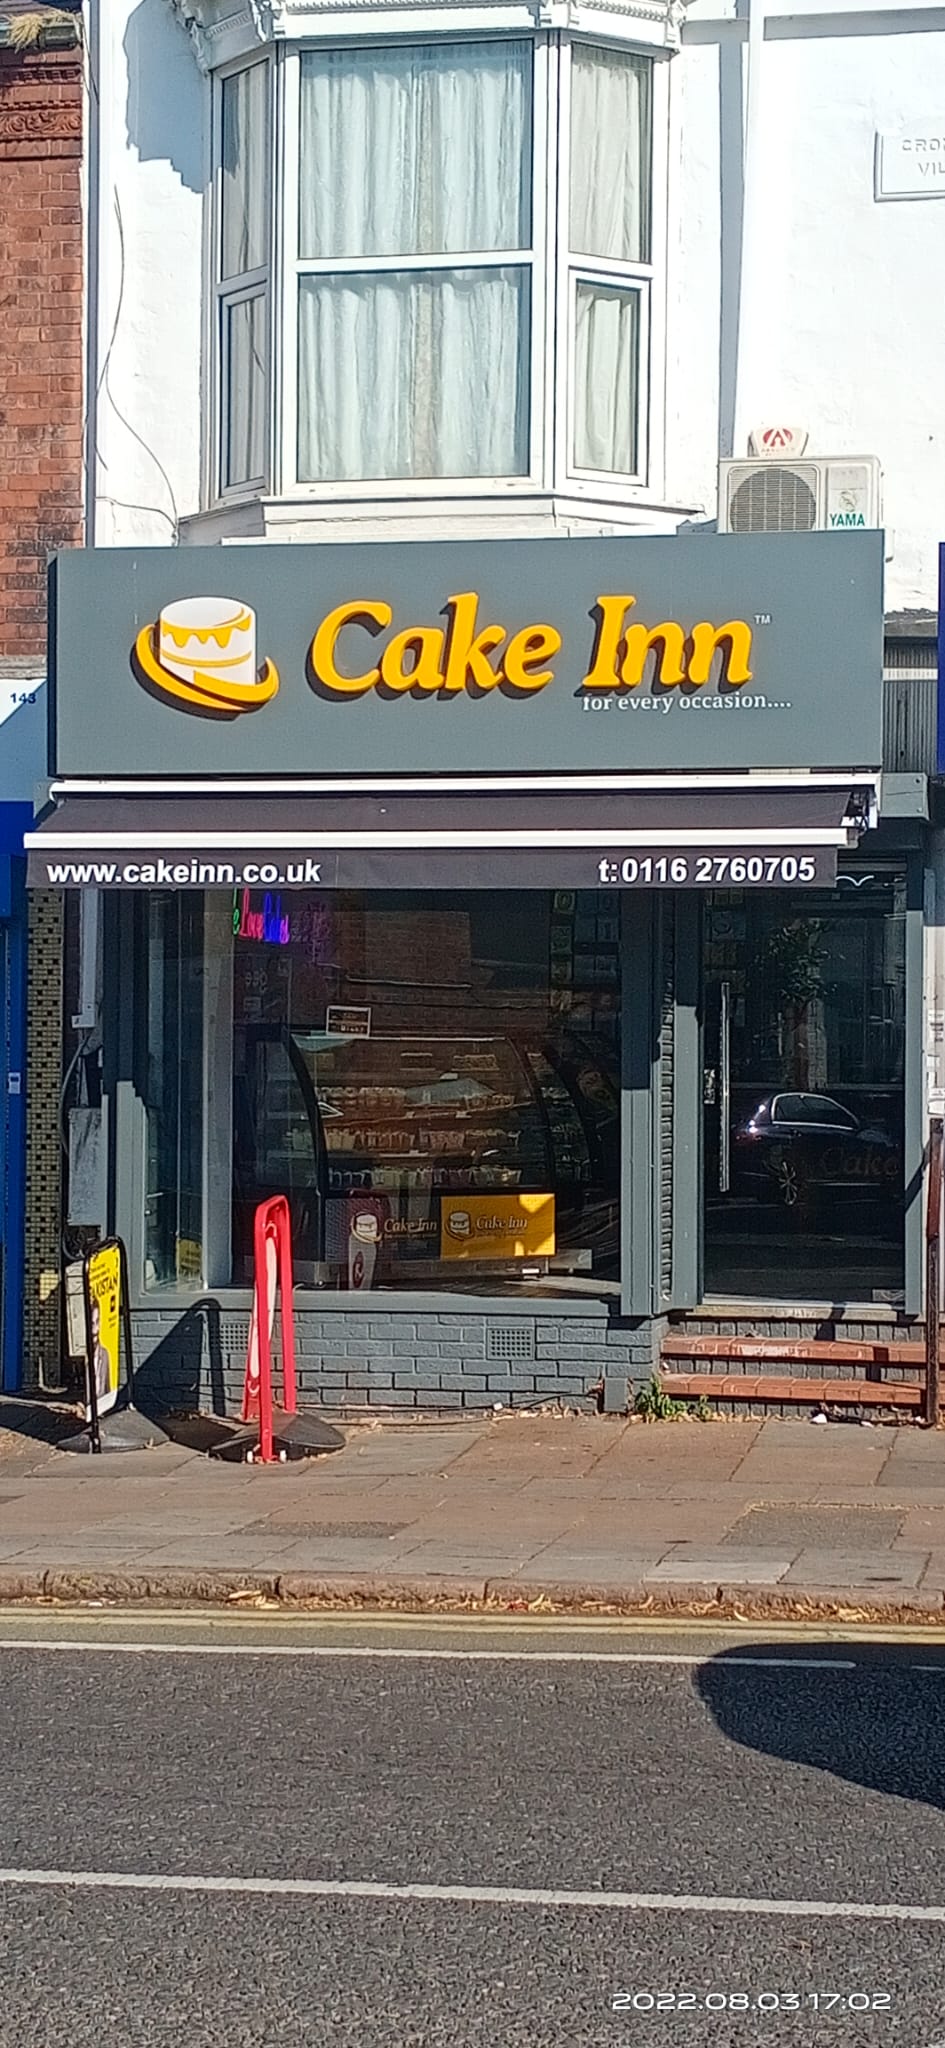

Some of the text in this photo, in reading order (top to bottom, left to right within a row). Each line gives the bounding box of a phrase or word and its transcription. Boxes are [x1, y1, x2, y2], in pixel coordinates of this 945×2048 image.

[829, 513, 865, 527] YAMA
[754, 614, 771, 625] TM
[310, 591, 753, 692] Cake Inn
[10, 692, 37, 704] 143
[583, 692, 792, 714] for every occasion....
[47, 858, 321, 884] www.cakeinn.co.uk
[599, 856, 815, 883] t:0116 2760705
